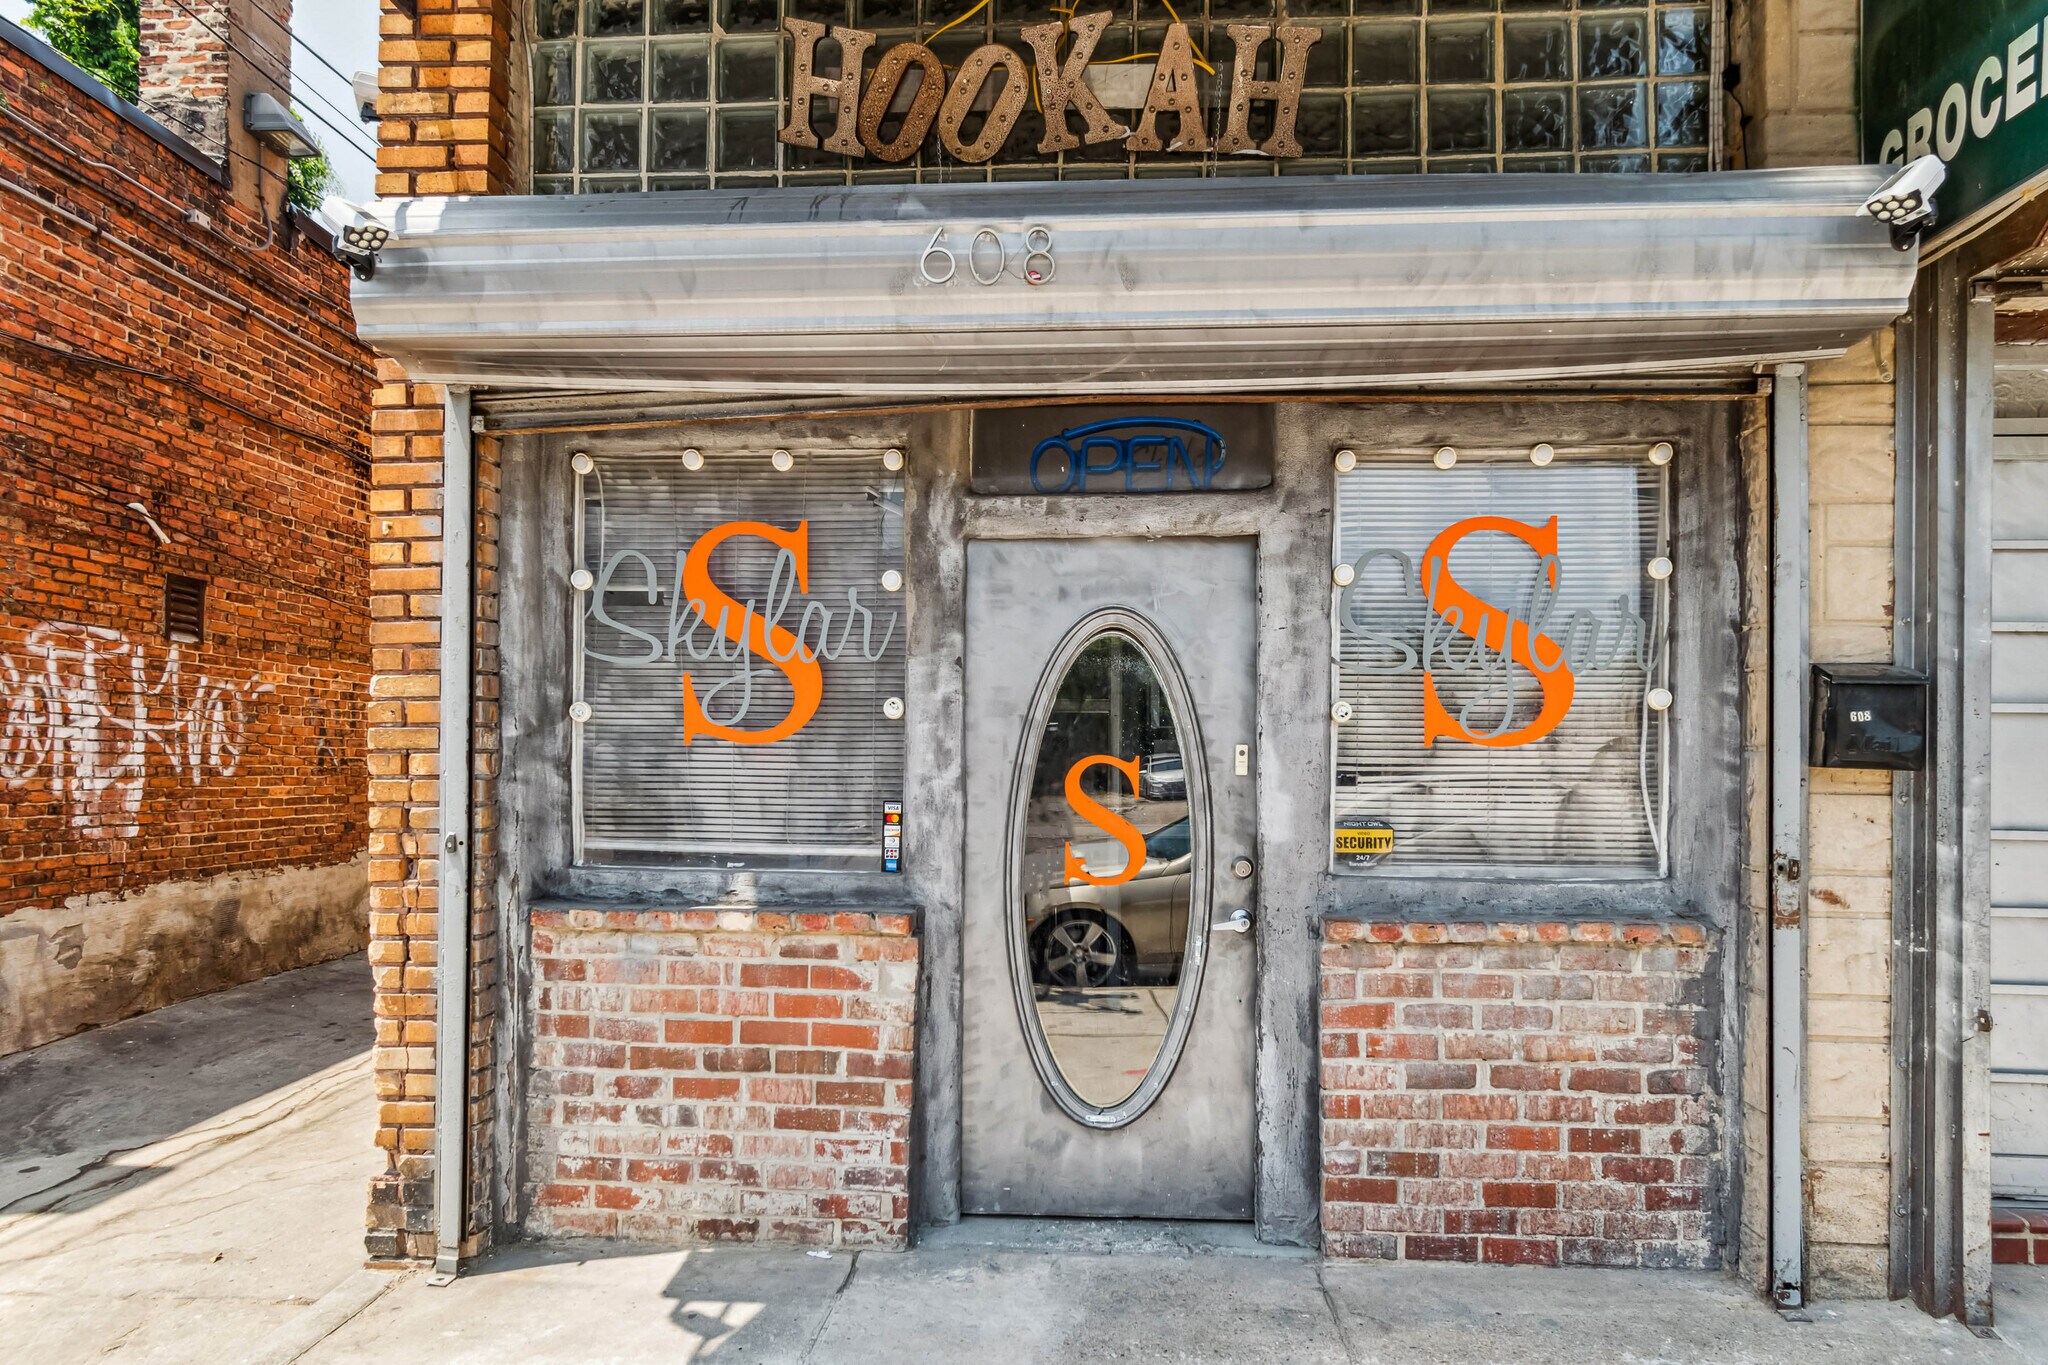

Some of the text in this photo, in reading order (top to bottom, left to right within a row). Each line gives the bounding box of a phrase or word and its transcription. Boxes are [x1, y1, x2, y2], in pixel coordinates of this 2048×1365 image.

[778, 10, 1323, 163] HOOKAH
[1879, 15, 2048, 166] GROCE
[920, 226, 1056, 286] 608
[1030, 435, 1214, 494] OPEN
[584, 548, 897, 726] Skylar
[683, 520, 823, 746] S
[1331, 548, 1669, 739] Skylar
[1421, 515, 1575, 748] S
[1850, 710, 1872, 722] 608
[1064, 754, 1147, 886] S
[1335, 836, 1391, 849] SECURITY
